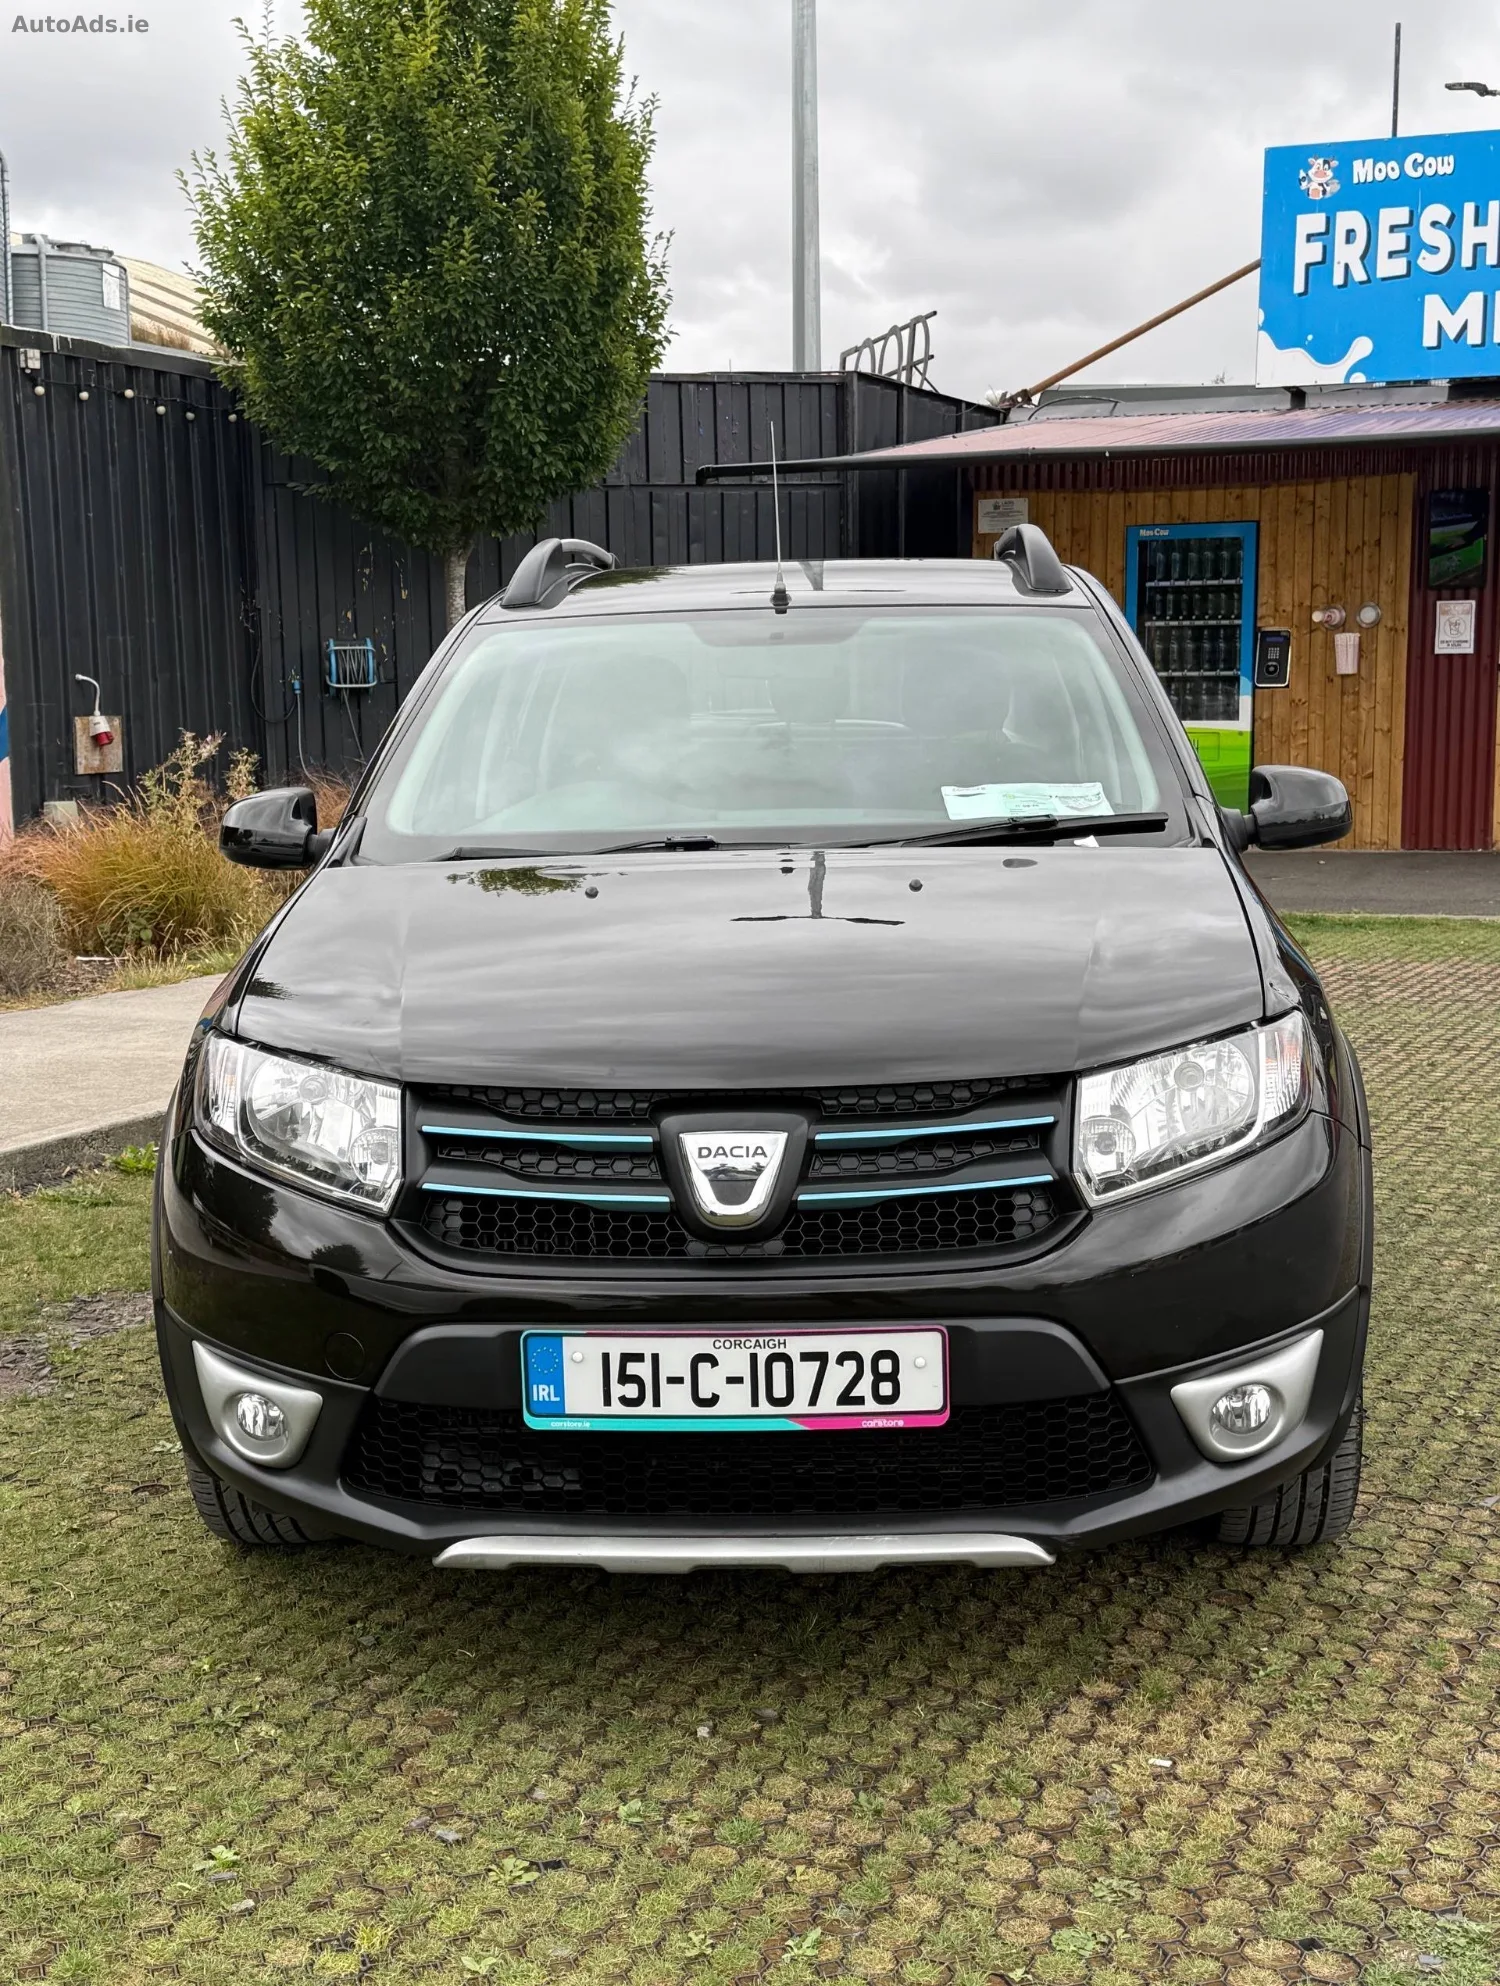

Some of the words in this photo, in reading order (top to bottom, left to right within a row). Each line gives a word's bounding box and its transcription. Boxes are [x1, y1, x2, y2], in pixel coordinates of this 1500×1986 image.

[1352, 158, 1400, 185] Moo
[1403, 152, 1455, 179] Cow
[1292, 199, 1500, 296] FRESH
[698, 1145, 768, 1158] DACIA
[712, 1337, 788, 1351] CORCAIGH
[601, 1349, 901, 1409] 151-C-10728
[532, 1384, 561, 1403] IRL
[861, 1418, 905, 1428] carstore
